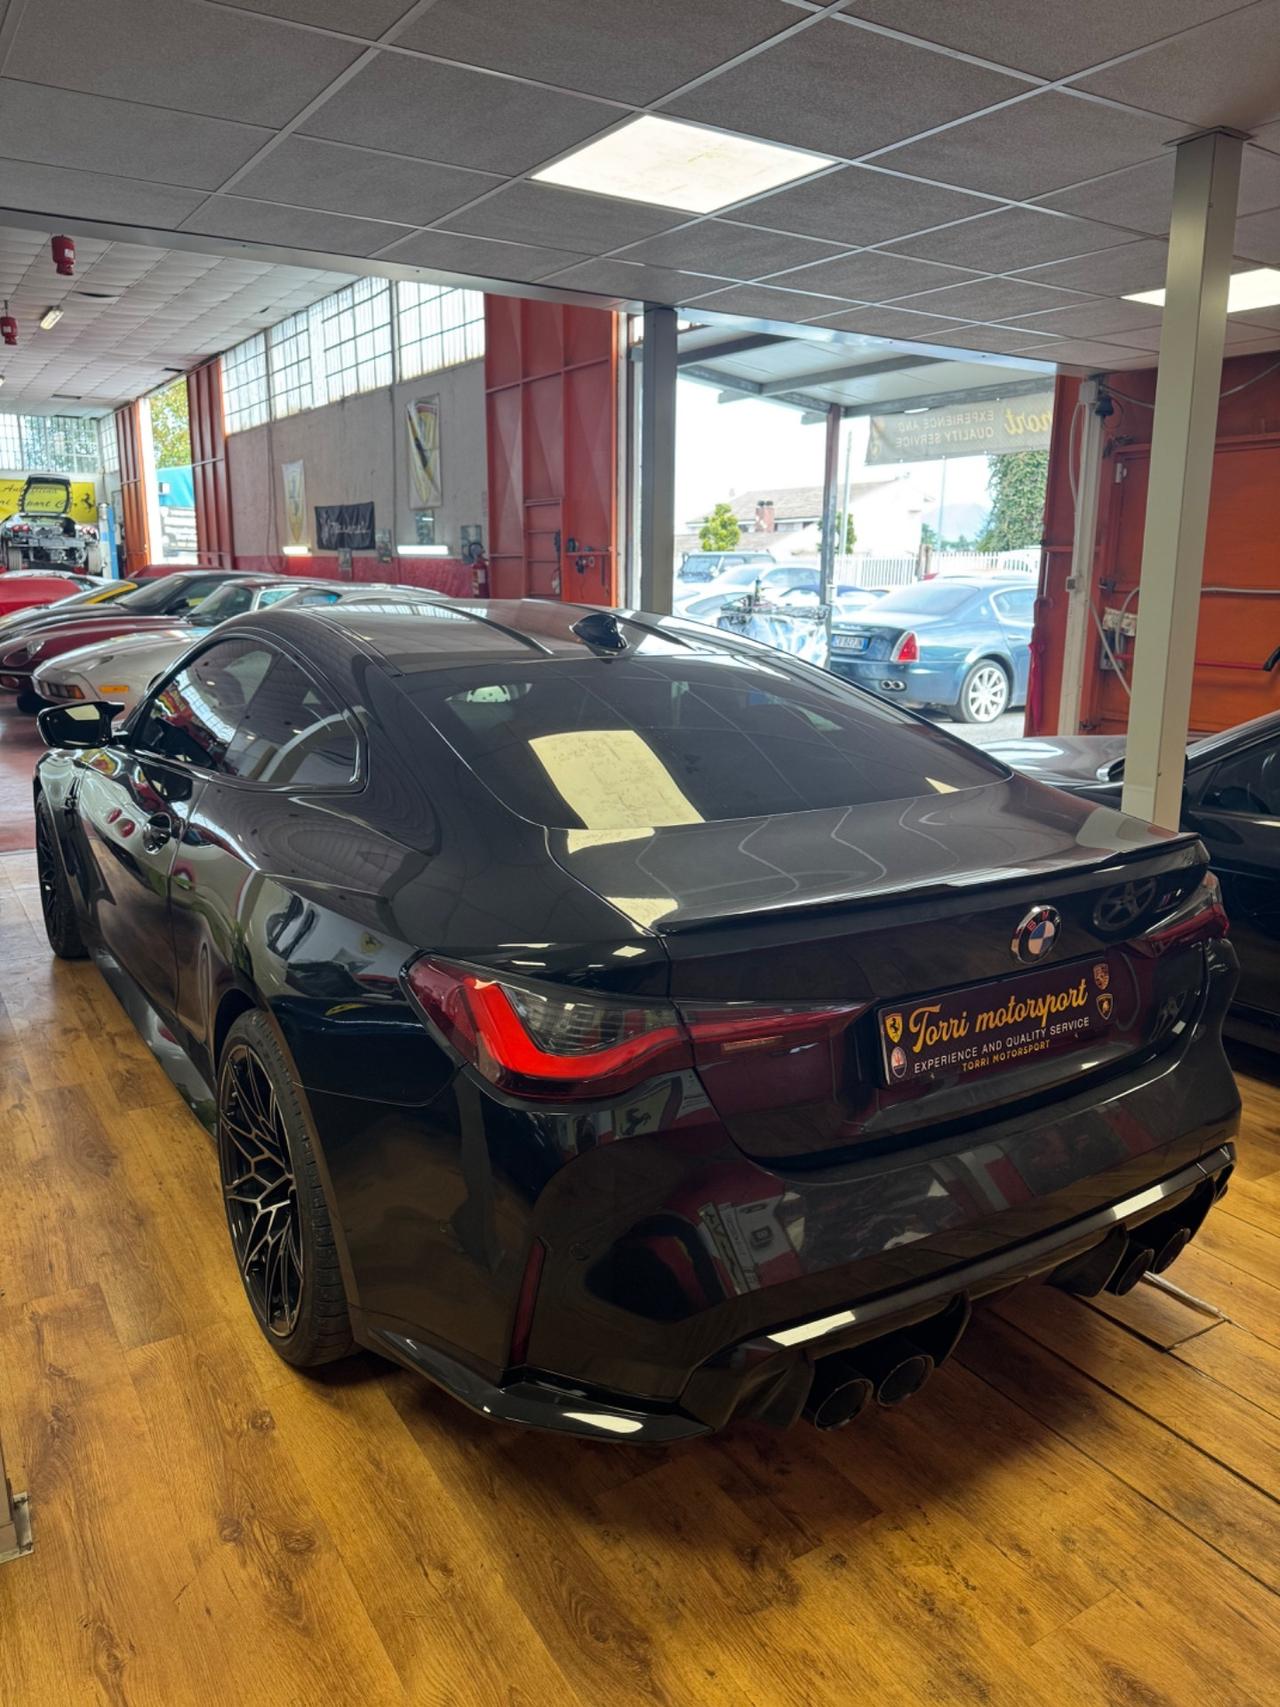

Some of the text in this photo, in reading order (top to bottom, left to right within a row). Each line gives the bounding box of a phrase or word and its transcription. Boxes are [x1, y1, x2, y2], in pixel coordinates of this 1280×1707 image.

[909, 978, 1088, 1053] Torri motorsport
[914, 1016, 1090, 1074] EXPERIENCE AND QUALITY SERVICE
[962, 1040, 1051, 1072] TORRI MOTORSPORT
